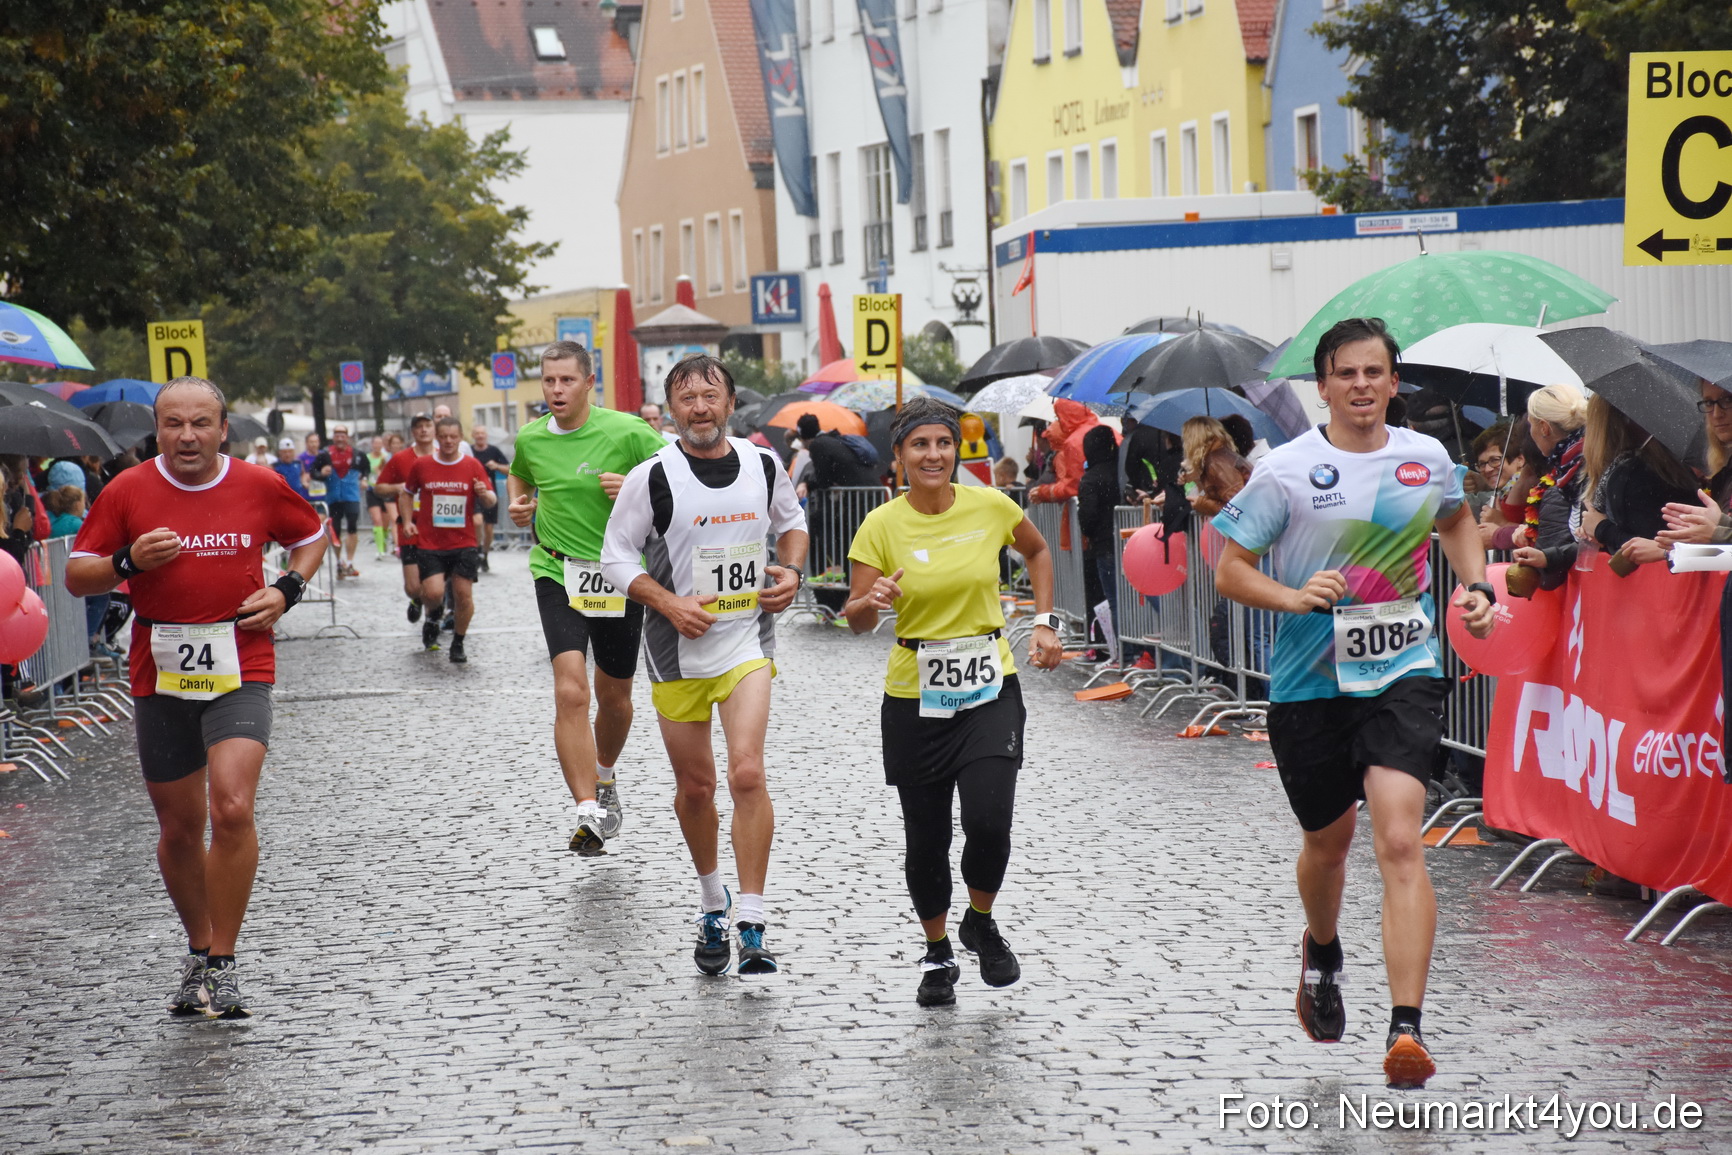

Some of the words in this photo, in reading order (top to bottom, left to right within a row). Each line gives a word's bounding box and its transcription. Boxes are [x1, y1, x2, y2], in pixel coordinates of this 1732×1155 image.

[1647, 61, 1732, 98] Bloc
[1052, 100, 1086, 137] HOTEL
[1662, 115, 1732, 220] C
[859, 297, 897, 312] Block
[155, 324, 198, 341] Block
[866, 318, 890, 357] D
[164, 346, 193, 382] D
[436, 503, 464, 516] 2604
[1312, 492, 1345, 504] PARTL
[1313, 500, 1347, 510] Neumarkt
[711, 512, 759, 525] KLEBL
[711, 560, 757, 592] 184
[583, 599, 607, 609] Bernd
[718, 598, 751, 611] Rainer
[1346, 619, 1424, 658] 3082
[177, 643, 215, 672] 24
[927, 655, 996, 688] 2545
[179, 678, 215, 693] Charly
